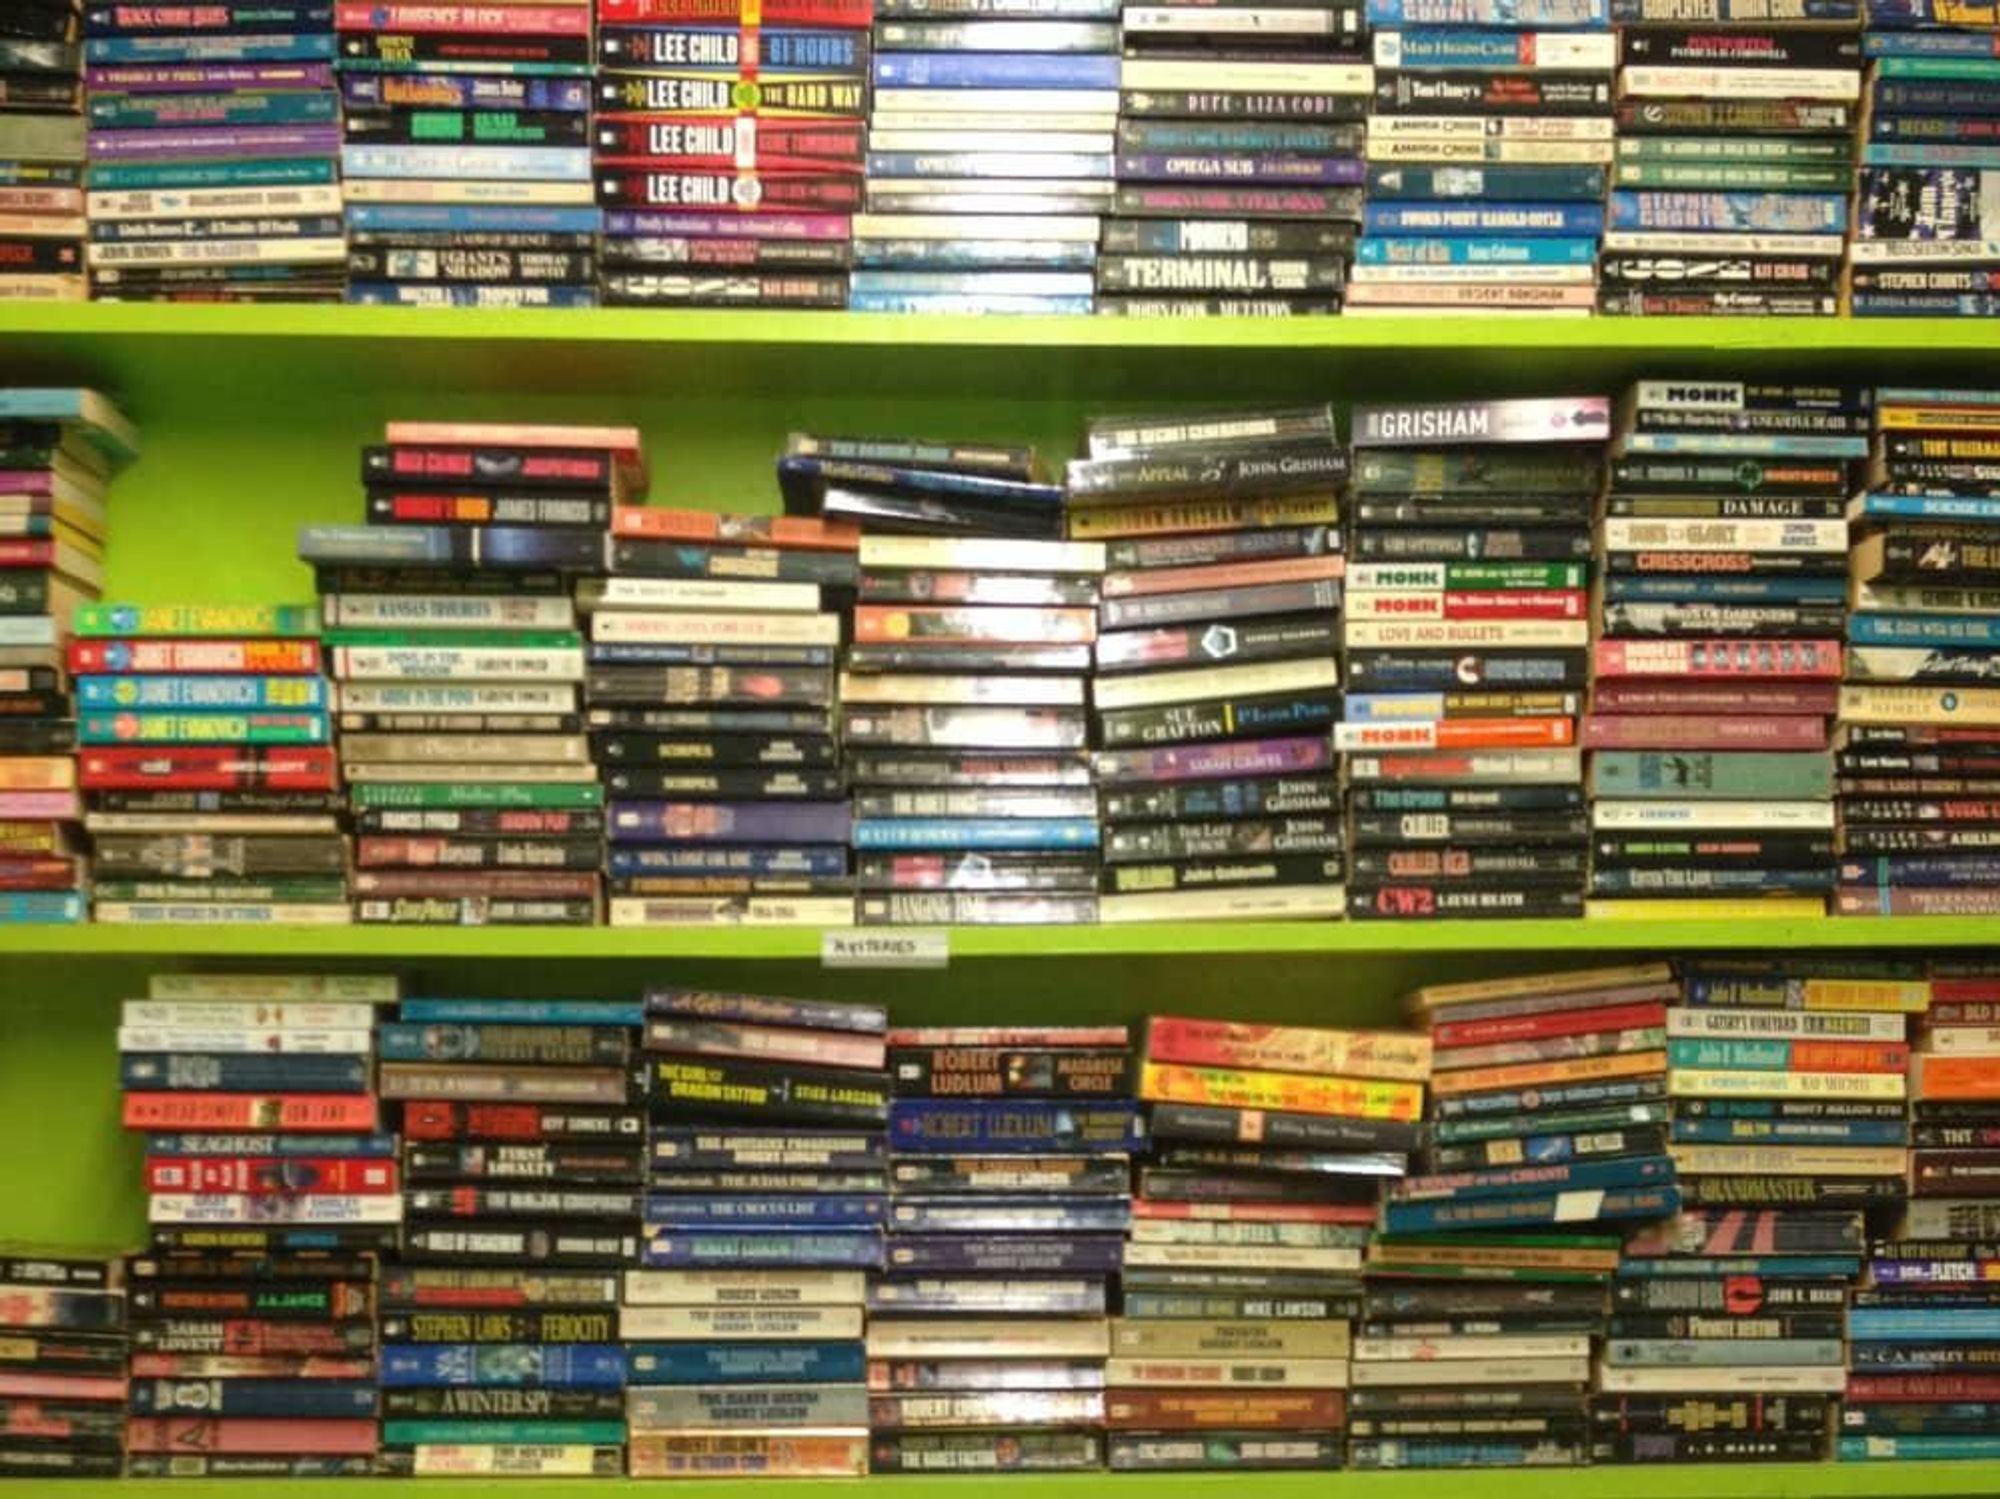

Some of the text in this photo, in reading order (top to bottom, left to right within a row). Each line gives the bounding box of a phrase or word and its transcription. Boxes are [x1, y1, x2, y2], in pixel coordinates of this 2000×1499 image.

[655, 35, 686, 62] LEE
[689, 34, 738, 62] CHILD
[648, 81, 678, 107] LEE
[681, 81, 729, 107] CHILD
[650, 125, 733, 153] LEE CHILD
[648, 175, 729, 203] LEE CHILD
[1123, 260, 1265, 288] TERMINAL
[1381, 410, 1488, 438] GRISHAM
[1723, 499, 1803, 515] DAMAGE
[1415, 628, 1445, 641] AND
